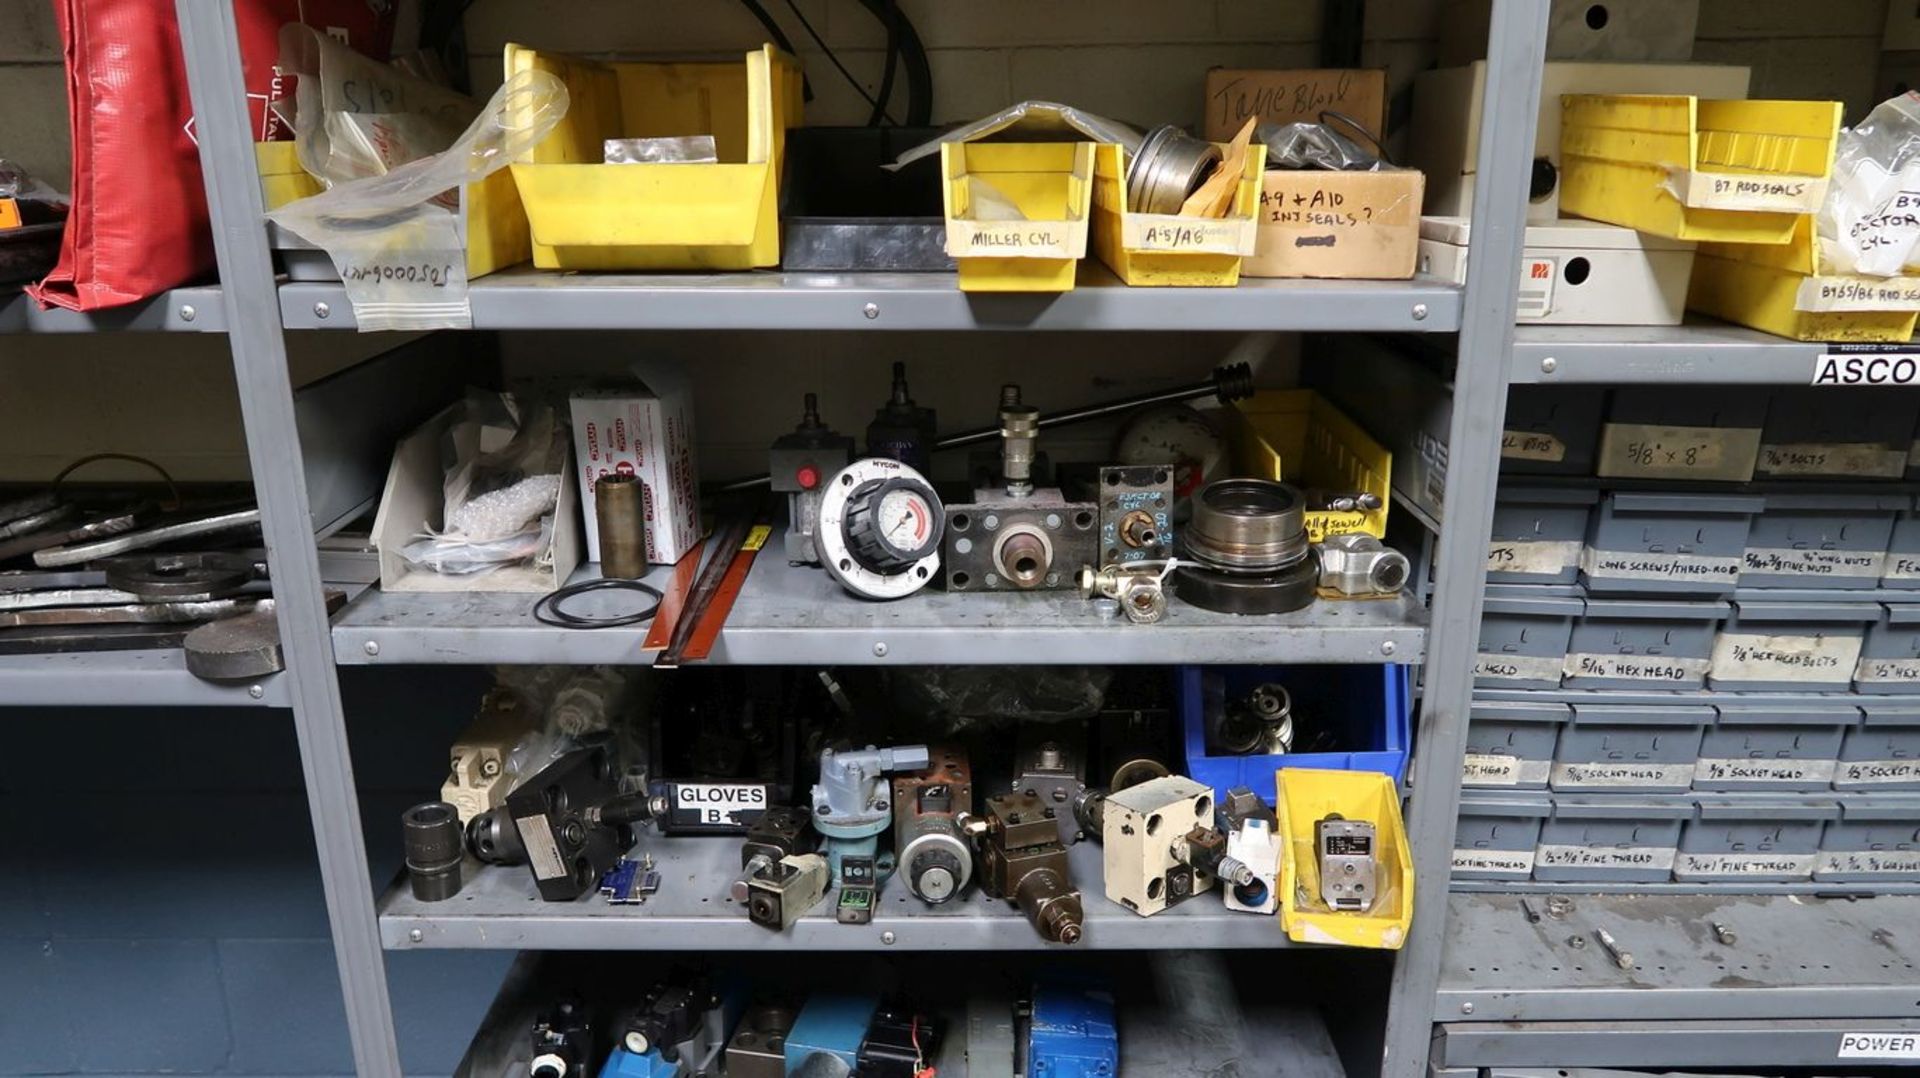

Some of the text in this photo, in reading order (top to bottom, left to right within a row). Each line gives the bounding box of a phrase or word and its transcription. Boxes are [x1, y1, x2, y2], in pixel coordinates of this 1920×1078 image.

[1310, 189, 1344, 208] A10
[1306, 212, 1357, 226] SEALS
[971, 232, 1022, 247] MILLER
[1816, 358, 1917, 385] ASCO
[1599, 561, 1627, 571] LONG
[1844, 556, 1872, 566] NUTS
[1802, 656, 1839, 668] BOLTS
[1616, 664, 1640, 676] HEX
[1643, 665, 1685, 680] HEAD
[1480, 765, 1511, 776] HEAD
[1588, 769, 1628, 778] SOCKET
[1630, 770, 1664, 780] HEAD
[1730, 767, 1769, 777] SOCKET
[1771, 769, 1803, 779] HEAD
[1869, 765, 1911, 777] SOCKET
[680, 787, 764, 803] GLOVES
[1583, 854, 1607, 864] FINE
[1612, 854, 1653, 864] THREAD
[1722, 861, 1750, 872] FINE
[1752, 861, 1797, 871] THREAD
[1843, 1036, 1916, 1051] POWER
